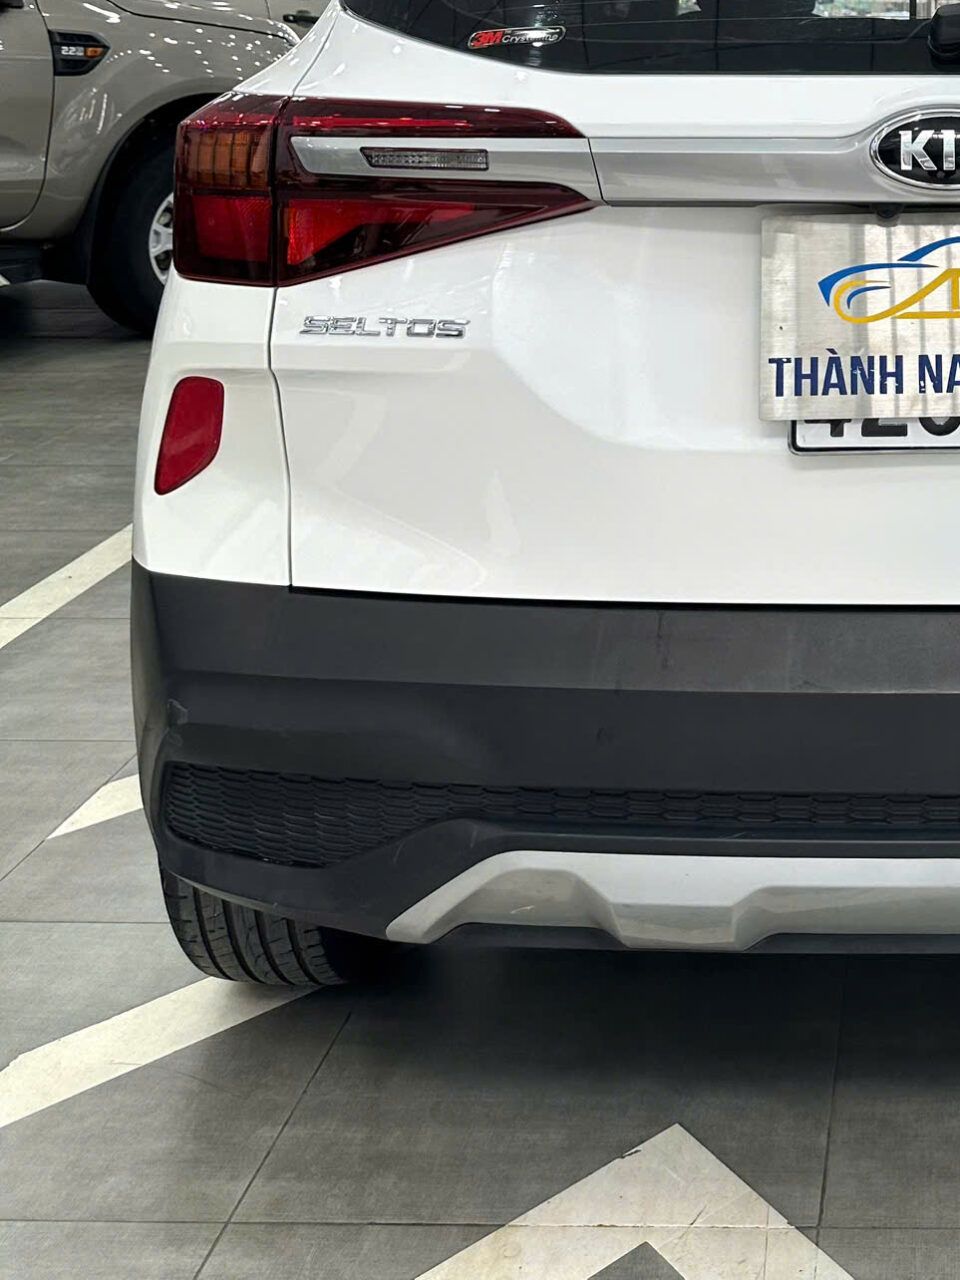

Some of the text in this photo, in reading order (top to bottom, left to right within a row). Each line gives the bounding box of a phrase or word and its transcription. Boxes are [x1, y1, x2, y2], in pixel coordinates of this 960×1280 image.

[472, 30, 505, 48] 3M
[300, 316, 470, 338] SELTOS
[768, 348, 904, 397] THÀNH
